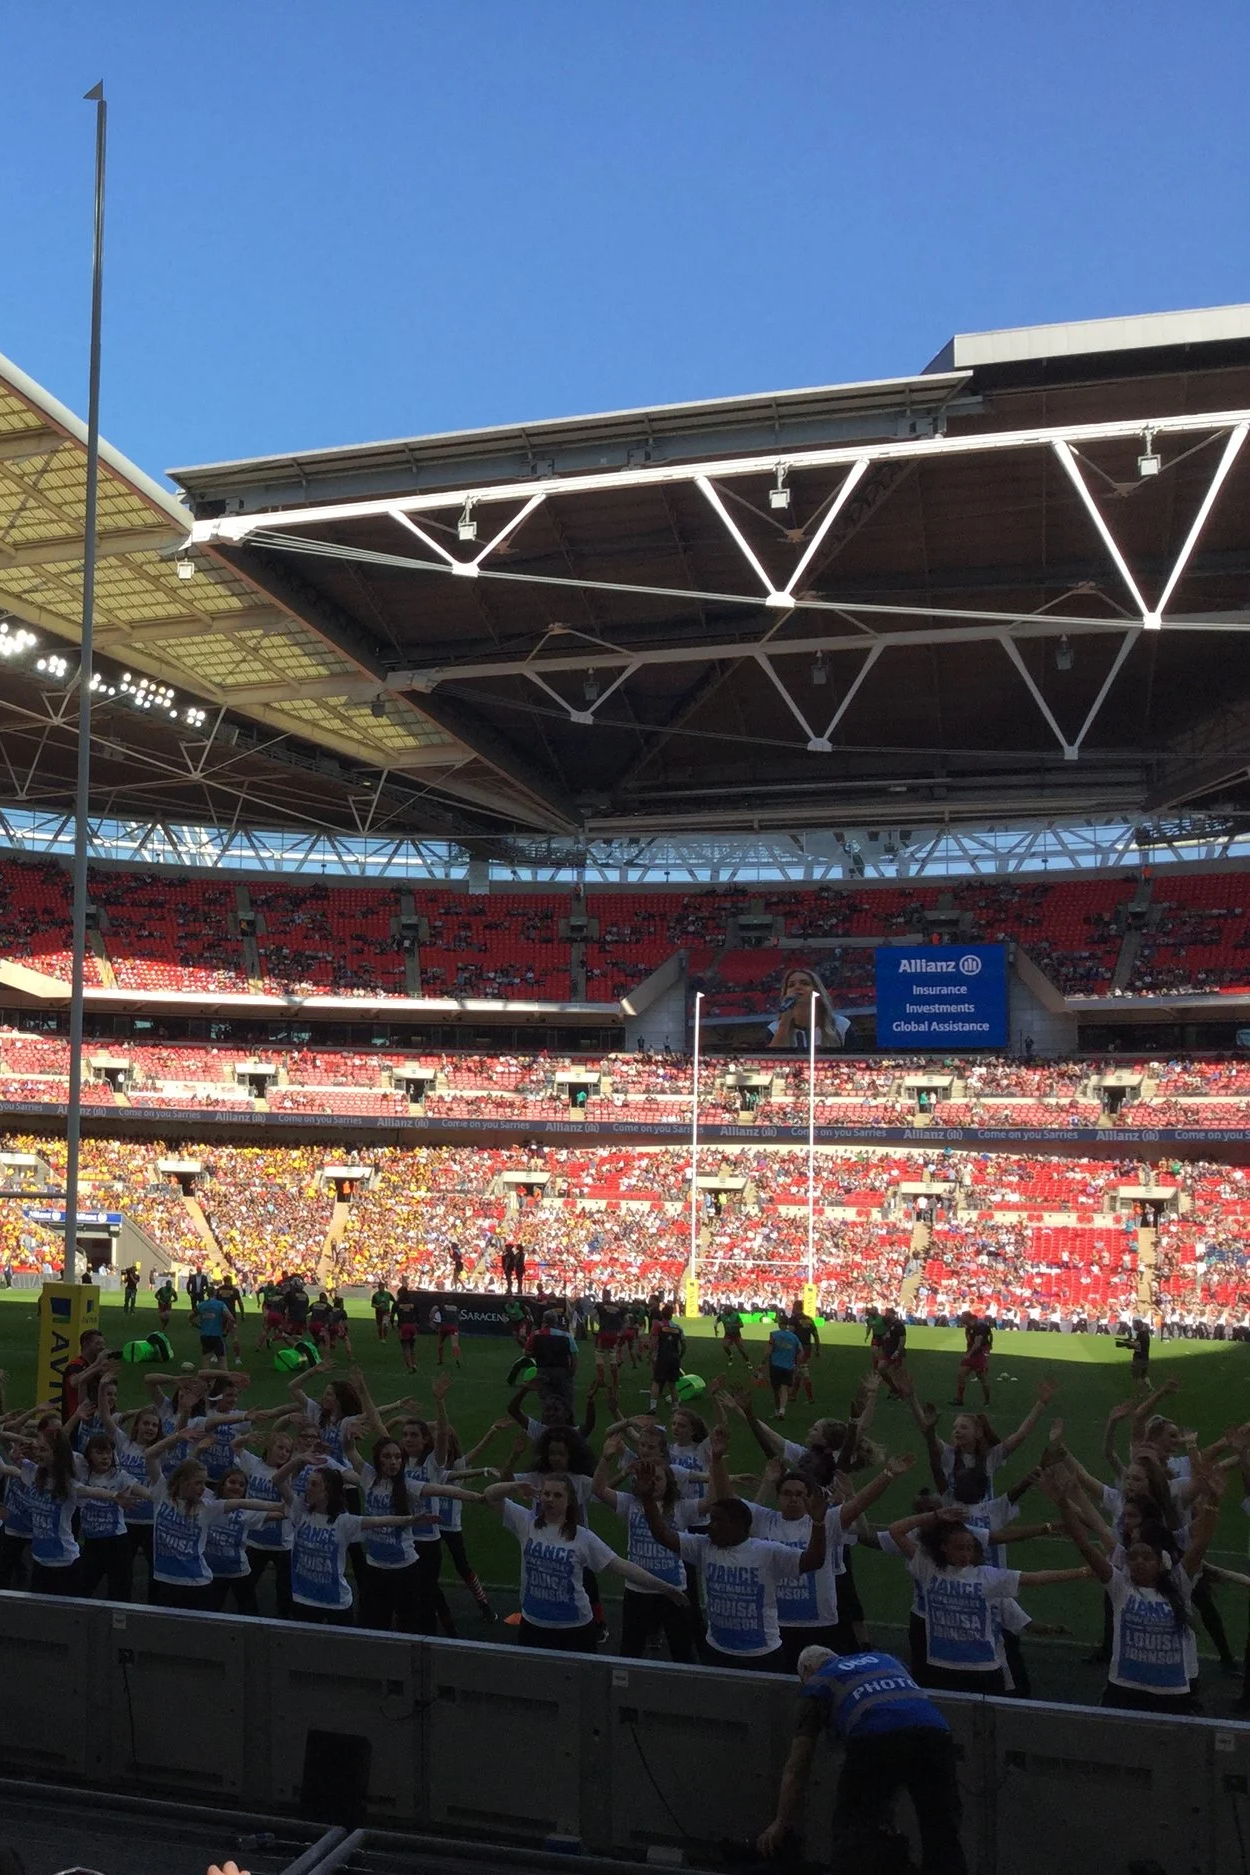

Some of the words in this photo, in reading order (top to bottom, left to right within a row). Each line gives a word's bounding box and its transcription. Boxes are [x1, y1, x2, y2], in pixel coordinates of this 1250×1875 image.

[899, 959, 956, 972] Allianz
[913, 985, 967, 995] Insurance
[906, 1003, 974, 1013] Investments
[893, 1021, 928, 1032] Global
[930, 1021, 989, 1032] Assistance
[0, 1102, 15, 1113] you
[16, 1101, 43, 1112] Sarries
[119, 1108, 141, 1118] Come
[143, 1110, 153, 1118] on
[155, 1110, 171, 1120] you
[172, 1109, 200, 1119] Sarries
[215, 1112, 250, 1122] Allianz
[278, 1114, 300, 1124] Come
[302, 1115, 315, 1124] on
[316, 1116, 332, 1127] you
[333, 1115, 362, 1125] Sarries
[377, 1117, 412, 1128] Allianz
[442, 1119, 467, 1128] Come
[469, 1120, 481, 1128] on
[482, 1120, 499, 1131] you
[500, 1119, 529, 1129] Sarries
[546, 1122, 582, 1132] Allianz
[613, 1123, 638, 1133] Come
[641, 1125, 654, 1133] on
[655, 1126, 671, 1136] you
[720, 1126, 759, 1136] Allianz
[820, 1129, 832, 1137] on
[834, 1130, 850, 1139] you
[852, 1128, 886, 1138] Sarries
[903, 1129, 944, 1140] Allianz
[978, 1129, 1005, 1139] Come
[1008, 1131, 1021, 1139] on
[1023, 1132, 1041, 1141] you
[1043, 1130, 1078, 1139] Sarries
[1096, 1131, 1139, 1140] Allianz
[1175, 1130, 1205, 1140] Come
[1206, 1132, 1220, 1140] on
[1222, 1132, 1240, 1142] you
[708, 1563, 759, 1583] DANCE
[931, 1576, 983, 1597] DANCE
[711, 1599, 758, 1617] LOUISA
[1127, 1594, 1173, 1616] DANC
[1126, 1630, 1181, 1650] LOUISA
[852, 1678, 919, 1700] PHOTO
